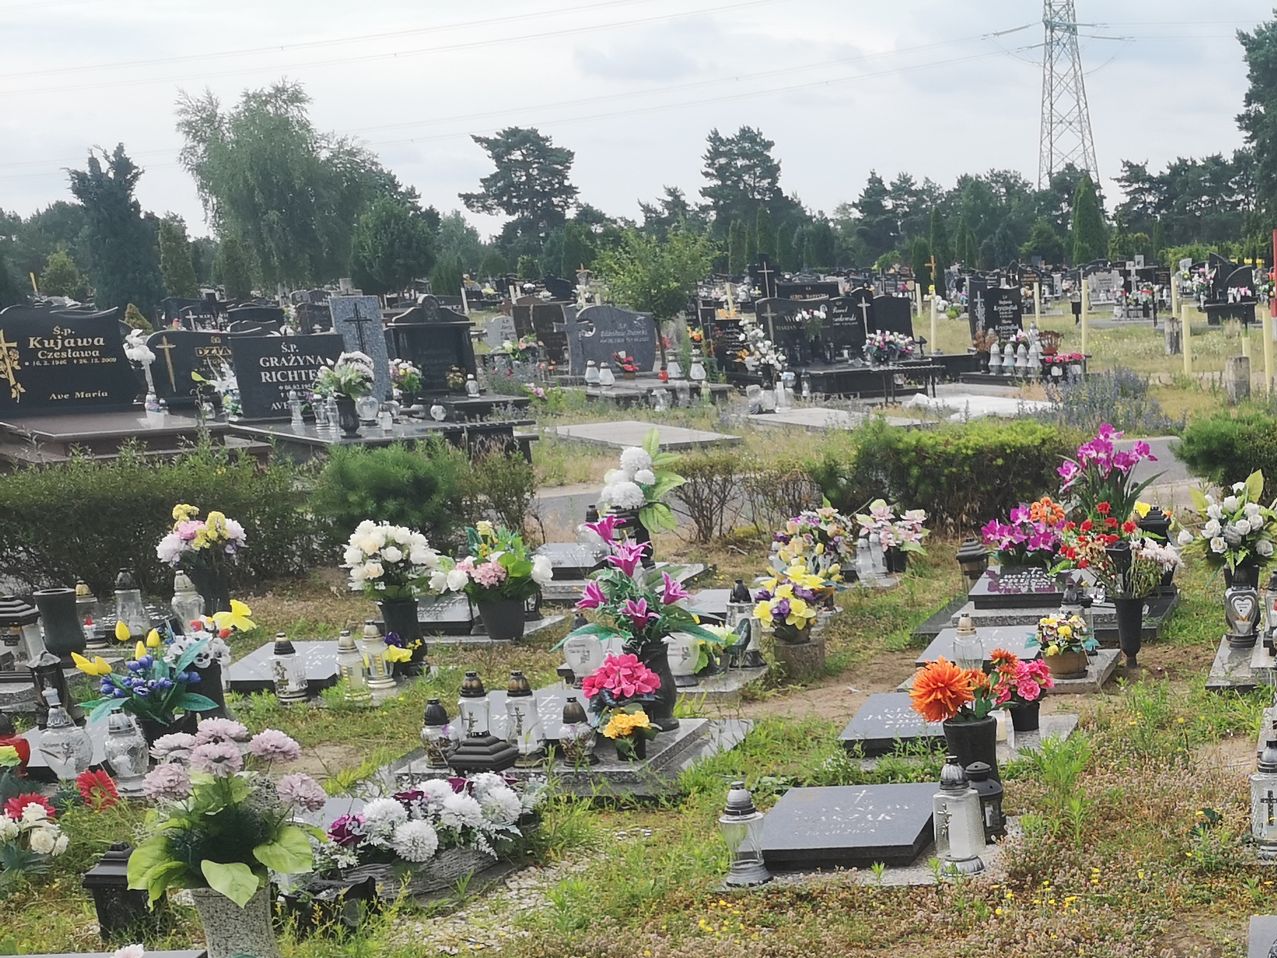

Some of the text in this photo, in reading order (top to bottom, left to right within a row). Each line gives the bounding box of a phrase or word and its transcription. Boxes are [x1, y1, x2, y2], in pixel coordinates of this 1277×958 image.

[28, 335, 105, 349] Kujawa
[38, 349, 100, 359] Czesława
[259, 354, 324, 367] GRAŻYNA
[260, 369, 320, 382] RICHTE
[75, 390, 108, 399] Maria
